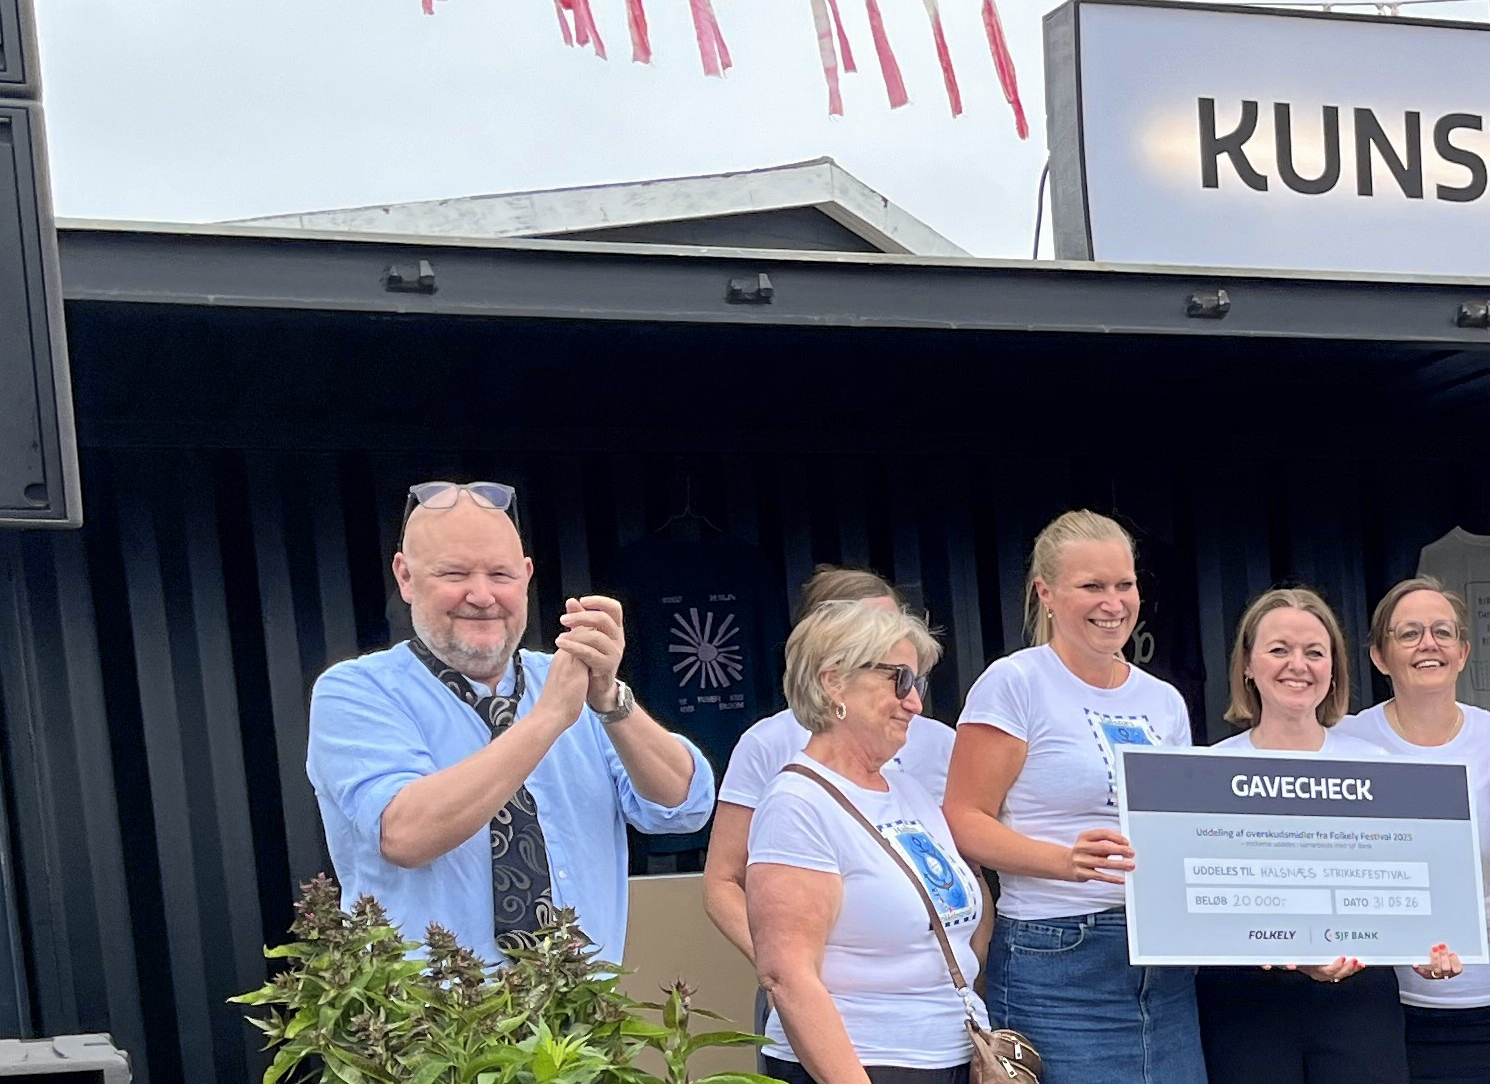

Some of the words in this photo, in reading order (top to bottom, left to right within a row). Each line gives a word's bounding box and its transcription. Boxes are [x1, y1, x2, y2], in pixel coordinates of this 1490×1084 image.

[1231, 775, 1374, 801] GAVECHECK
[1196, 828, 1233, 839] Uddeling
[1236, 829, 1244, 838] af
[1316, 831, 1328, 840] fra
[1330, 831, 1358, 841] Folkely
[1361, 832, 1391, 841] Festival
[1193, 866, 1238, 876] UDDELES
[1240, 867, 1255, 876] TIL
[1261, 867, 1317, 878] HALSNÆS
[1323, 868, 1411, 880] STRIKKEFESTIVAL
[1195, 896, 1228, 905] BELØB
[1343, 898, 1369, 907] DATO
[1248, 930, 1297, 940] FOLKELY
[1335, 932, 1349, 940] SJF
[1351, 932, 1378, 940] BANK
